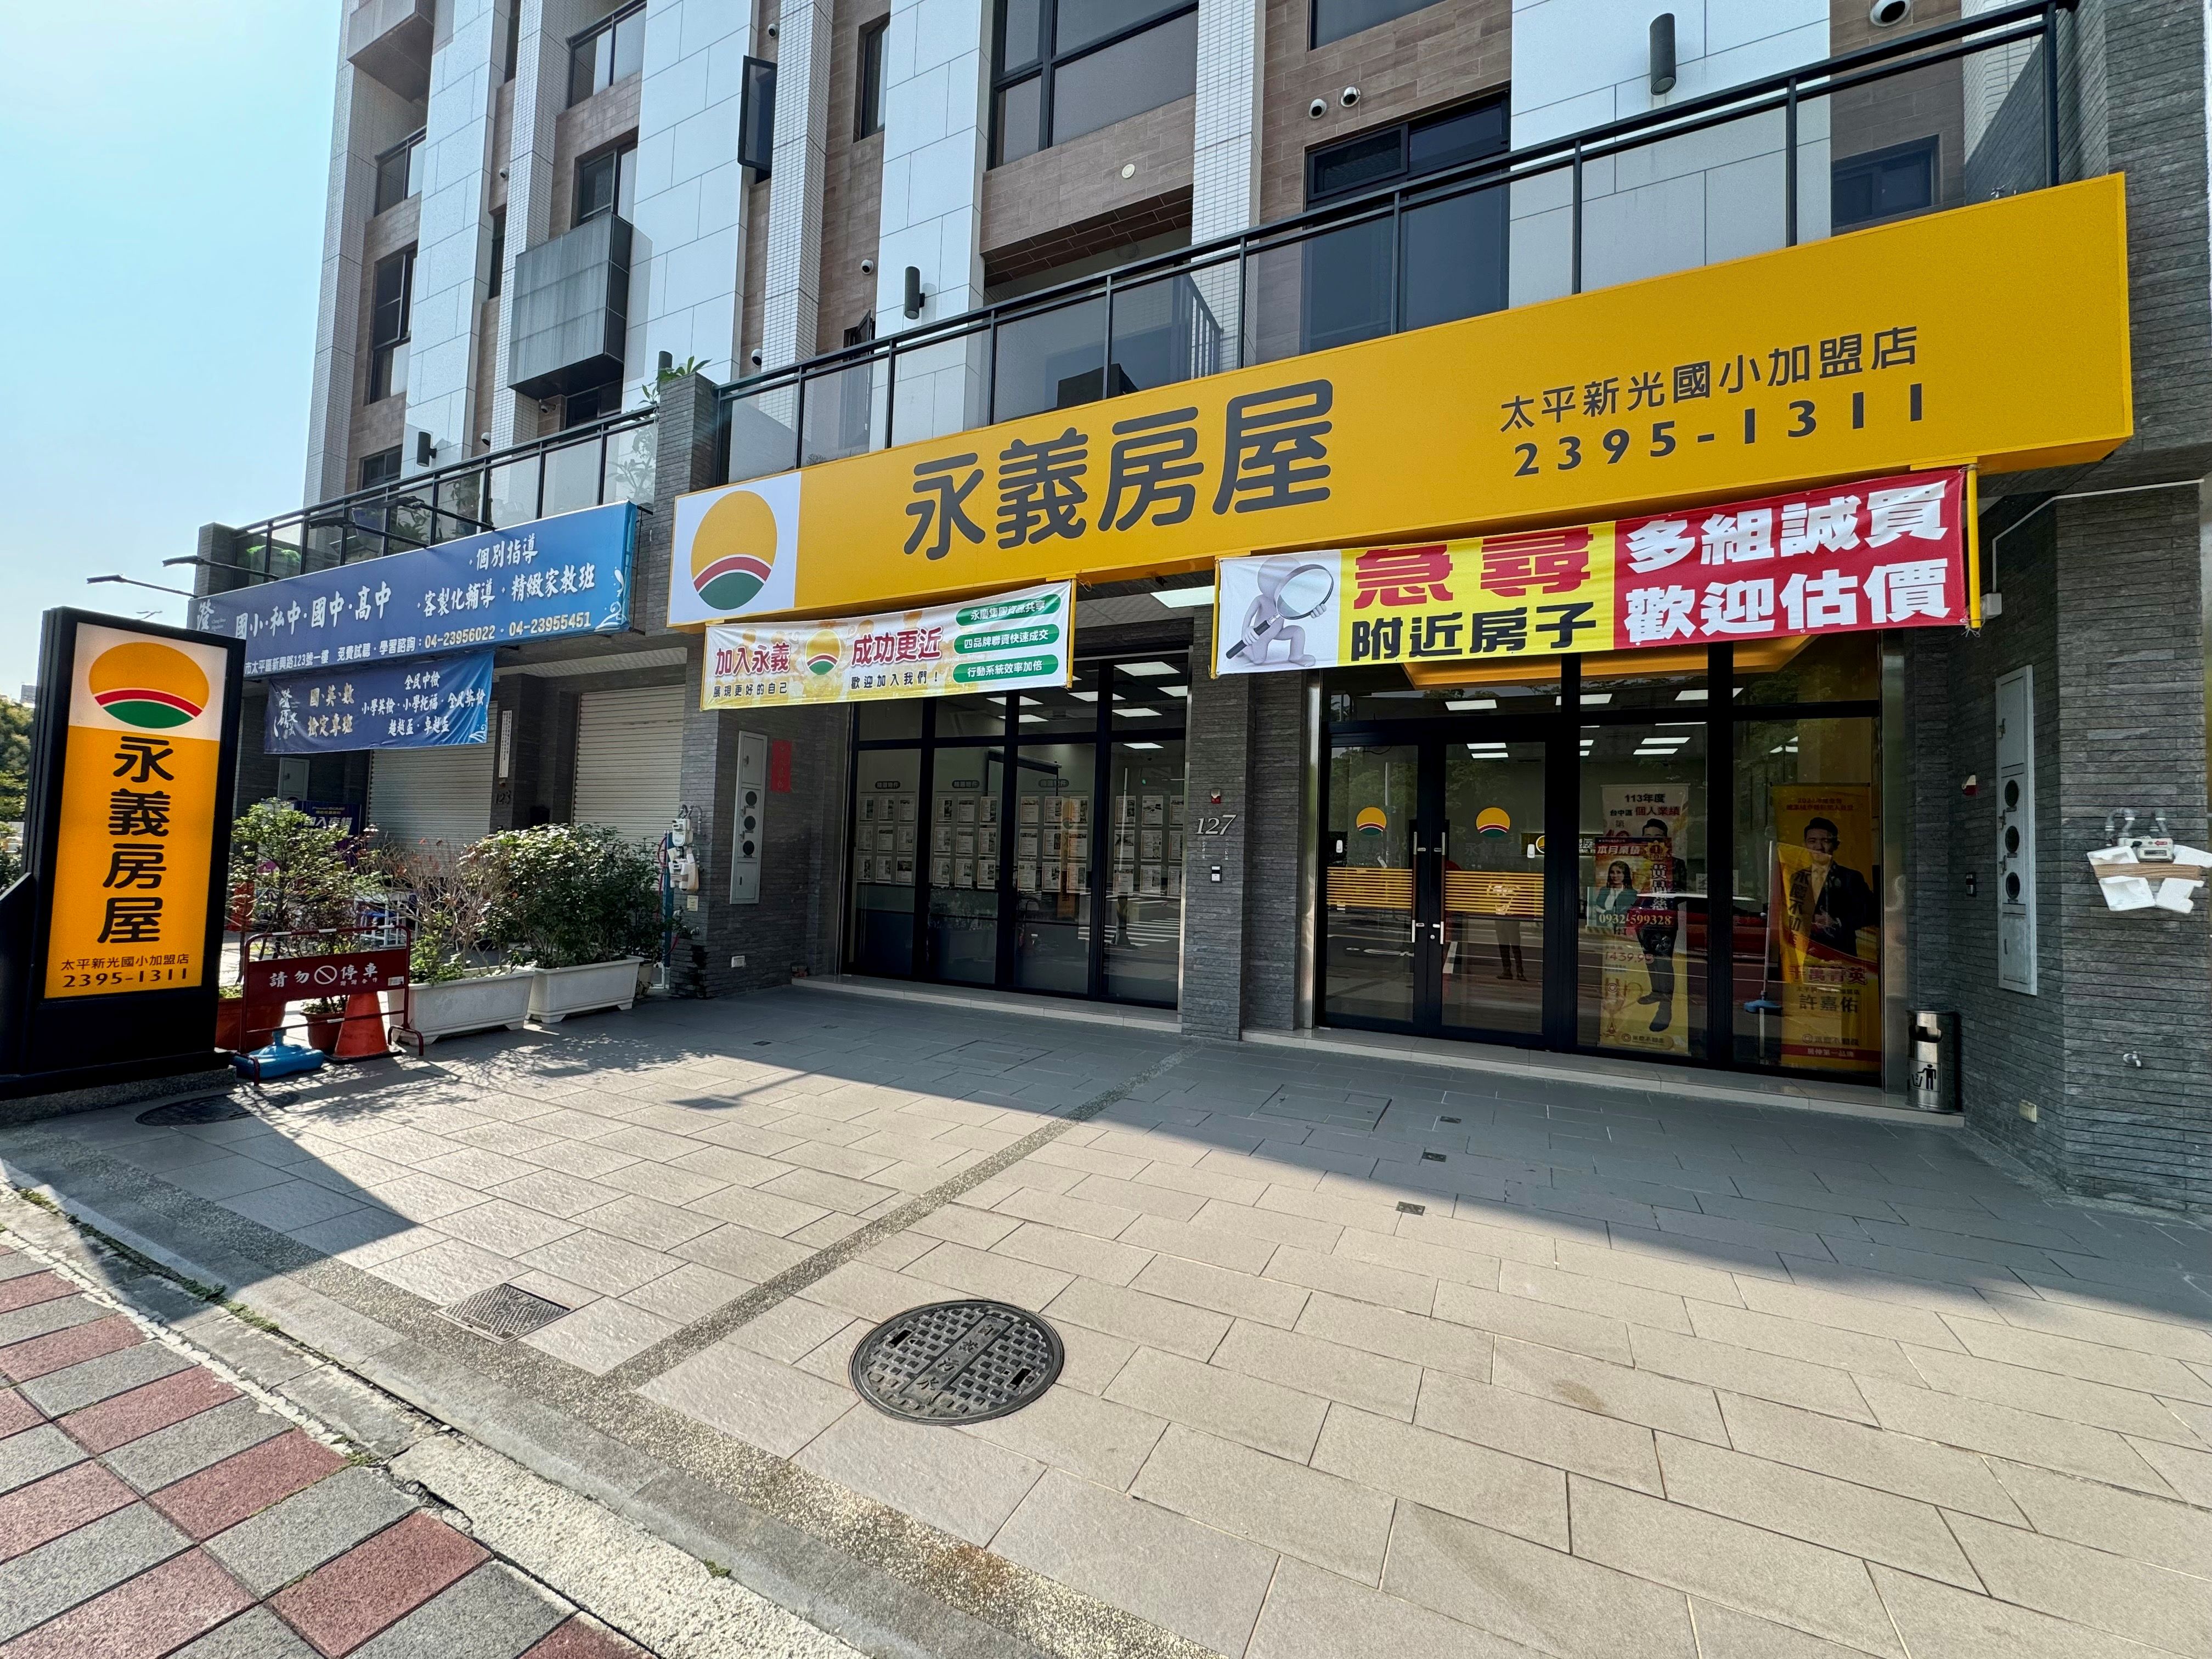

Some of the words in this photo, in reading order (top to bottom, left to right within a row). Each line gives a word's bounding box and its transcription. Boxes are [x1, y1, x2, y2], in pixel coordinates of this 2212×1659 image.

[1500, 326, 1918, 433] 太平新光國小加盟店
[1513, 383, 1923, 477] 2395-1311
[903, 379, 1334, 560] 永義房屋
[1626, 479, 1949, 576] 多組誠買
[1353, 529, 1594, 611] 急尋
[970, 600, 1046, 621] 永慶集團資源共享
[1625, 557, 1950, 646] 歡迎估價
[425, 624, 496, 649] 04-23956022
[509, 611, 592, 637] 04-23955451
[851, 627, 943, 665] 成功更近
[964, 629, 1049, 649] 四品牌聯賣快速成交
[1350, 601, 1597, 663] 附近房子
[715, 642, 790, 675] 加入永義
[967, 660, 1043, 678] 行動系統效率加倍
[404, 670, 441, 690] 全民中檢
[713, 682, 787, 698] 展現更好的自己
[1625, 794, 1666, 804] 113年度
[97, 736, 174, 944] 永義房屋
[1195, 814, 1238, 835] 127
[61, 953, 190, 970] 太平新光國小加盟店
[63, 968, 187, 988] 2395-1311
